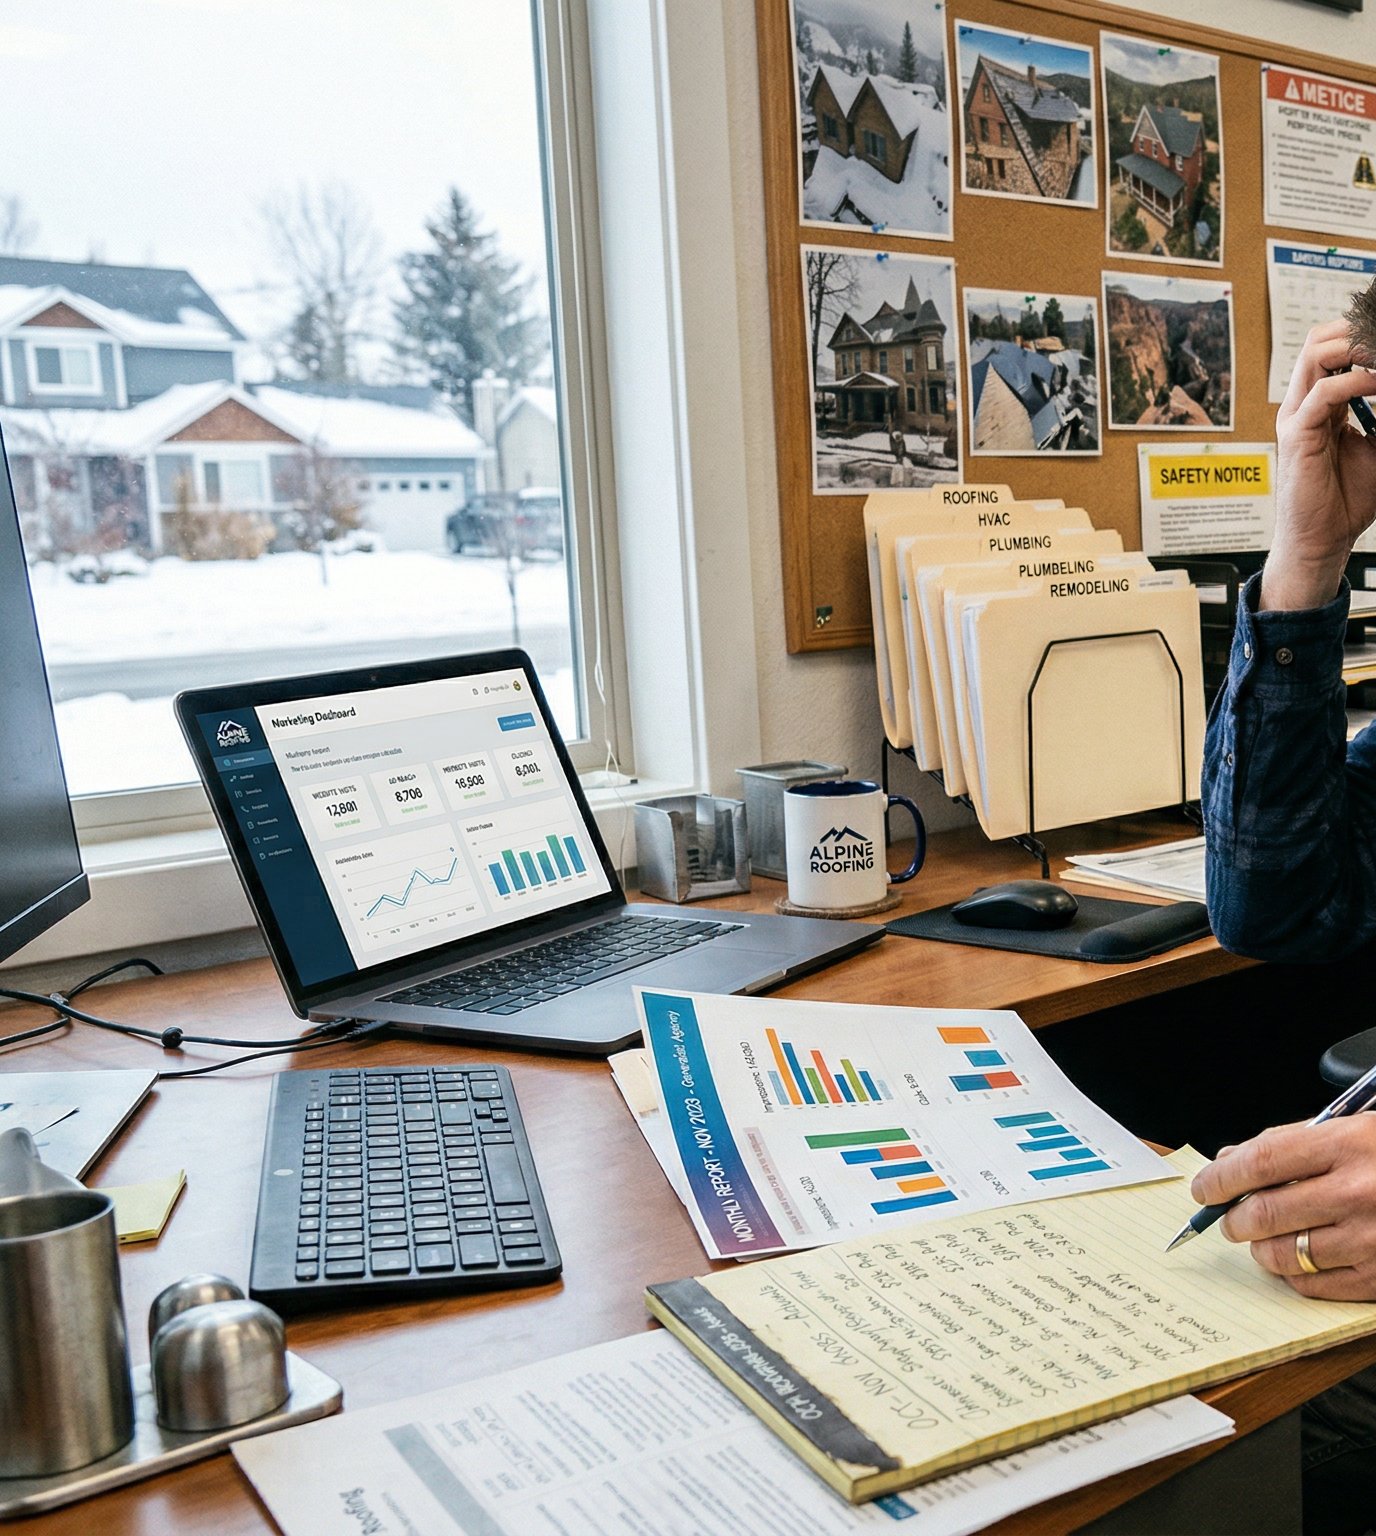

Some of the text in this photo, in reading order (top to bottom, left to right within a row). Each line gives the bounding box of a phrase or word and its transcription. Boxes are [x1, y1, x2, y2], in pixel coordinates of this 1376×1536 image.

[1302, 81, 1365, 114] METICE
[1160, 466, 1261, 485] SAFETY NOTICE
[943, 490, 998, 505] ROOFING
[978, 513, 1011, 526] HVAC
[990, 536, 1051, 552] PLUMBING
[1019, 560, 1094, 578] PLUMBELING
[1050, 579, 1130, 598] REMODELING
[810, 842, 874, 860] ALPINE
[810, 857, 874, 874] ROOFING
[684, 1098, 706, 1124] 2023
[692, 1126, 715, 1149] NOV
[702, 1157, 735, 1198] REPORT
[854, 1372, 892, 1397] NOV
